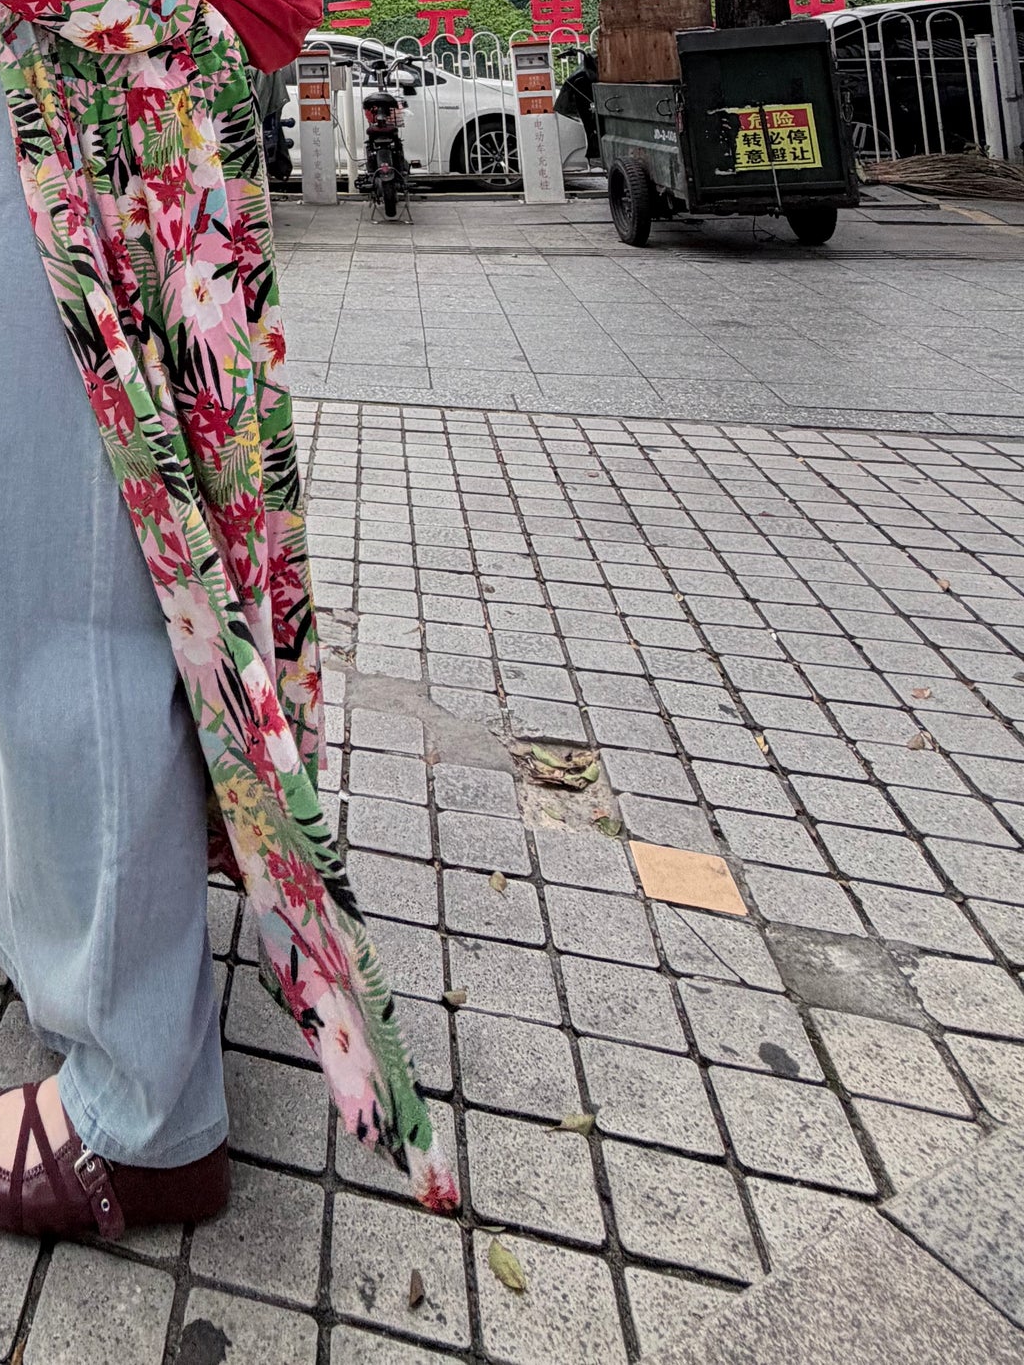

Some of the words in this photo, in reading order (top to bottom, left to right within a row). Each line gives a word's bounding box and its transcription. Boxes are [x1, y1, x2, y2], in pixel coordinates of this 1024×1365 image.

[747, 111, 796, 129] 危险
[736, 129, 808, 148] 转必停
